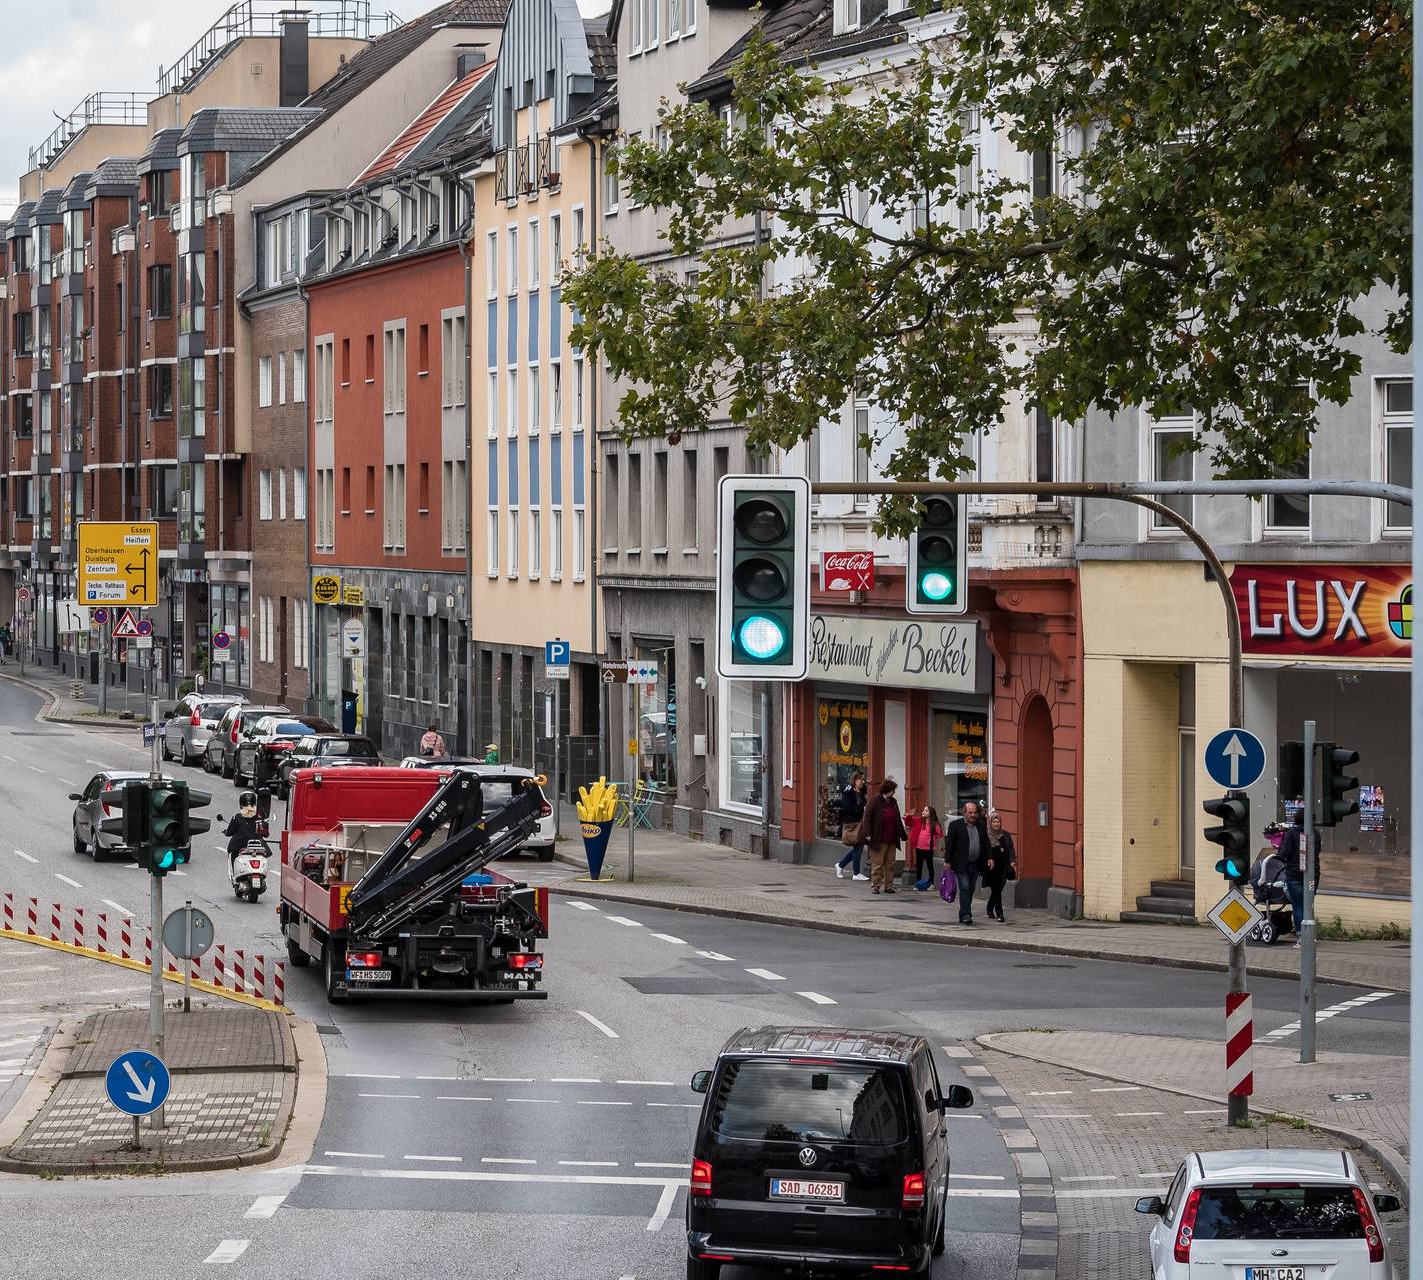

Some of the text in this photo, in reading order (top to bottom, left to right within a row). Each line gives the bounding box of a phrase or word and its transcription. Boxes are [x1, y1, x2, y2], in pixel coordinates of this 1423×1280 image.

[826, 553, 872, 571] Coca-Cola
[1248, 579, 1369, 640] LUX
[551, 644, 565, 663] P
[809, 615, 874, 677] Restaurant
[902, 623, 971, 677] Becker
[780, 1182, 839, 1196] SAD 06281
[1253, 1269, 1269, 1280] MH
